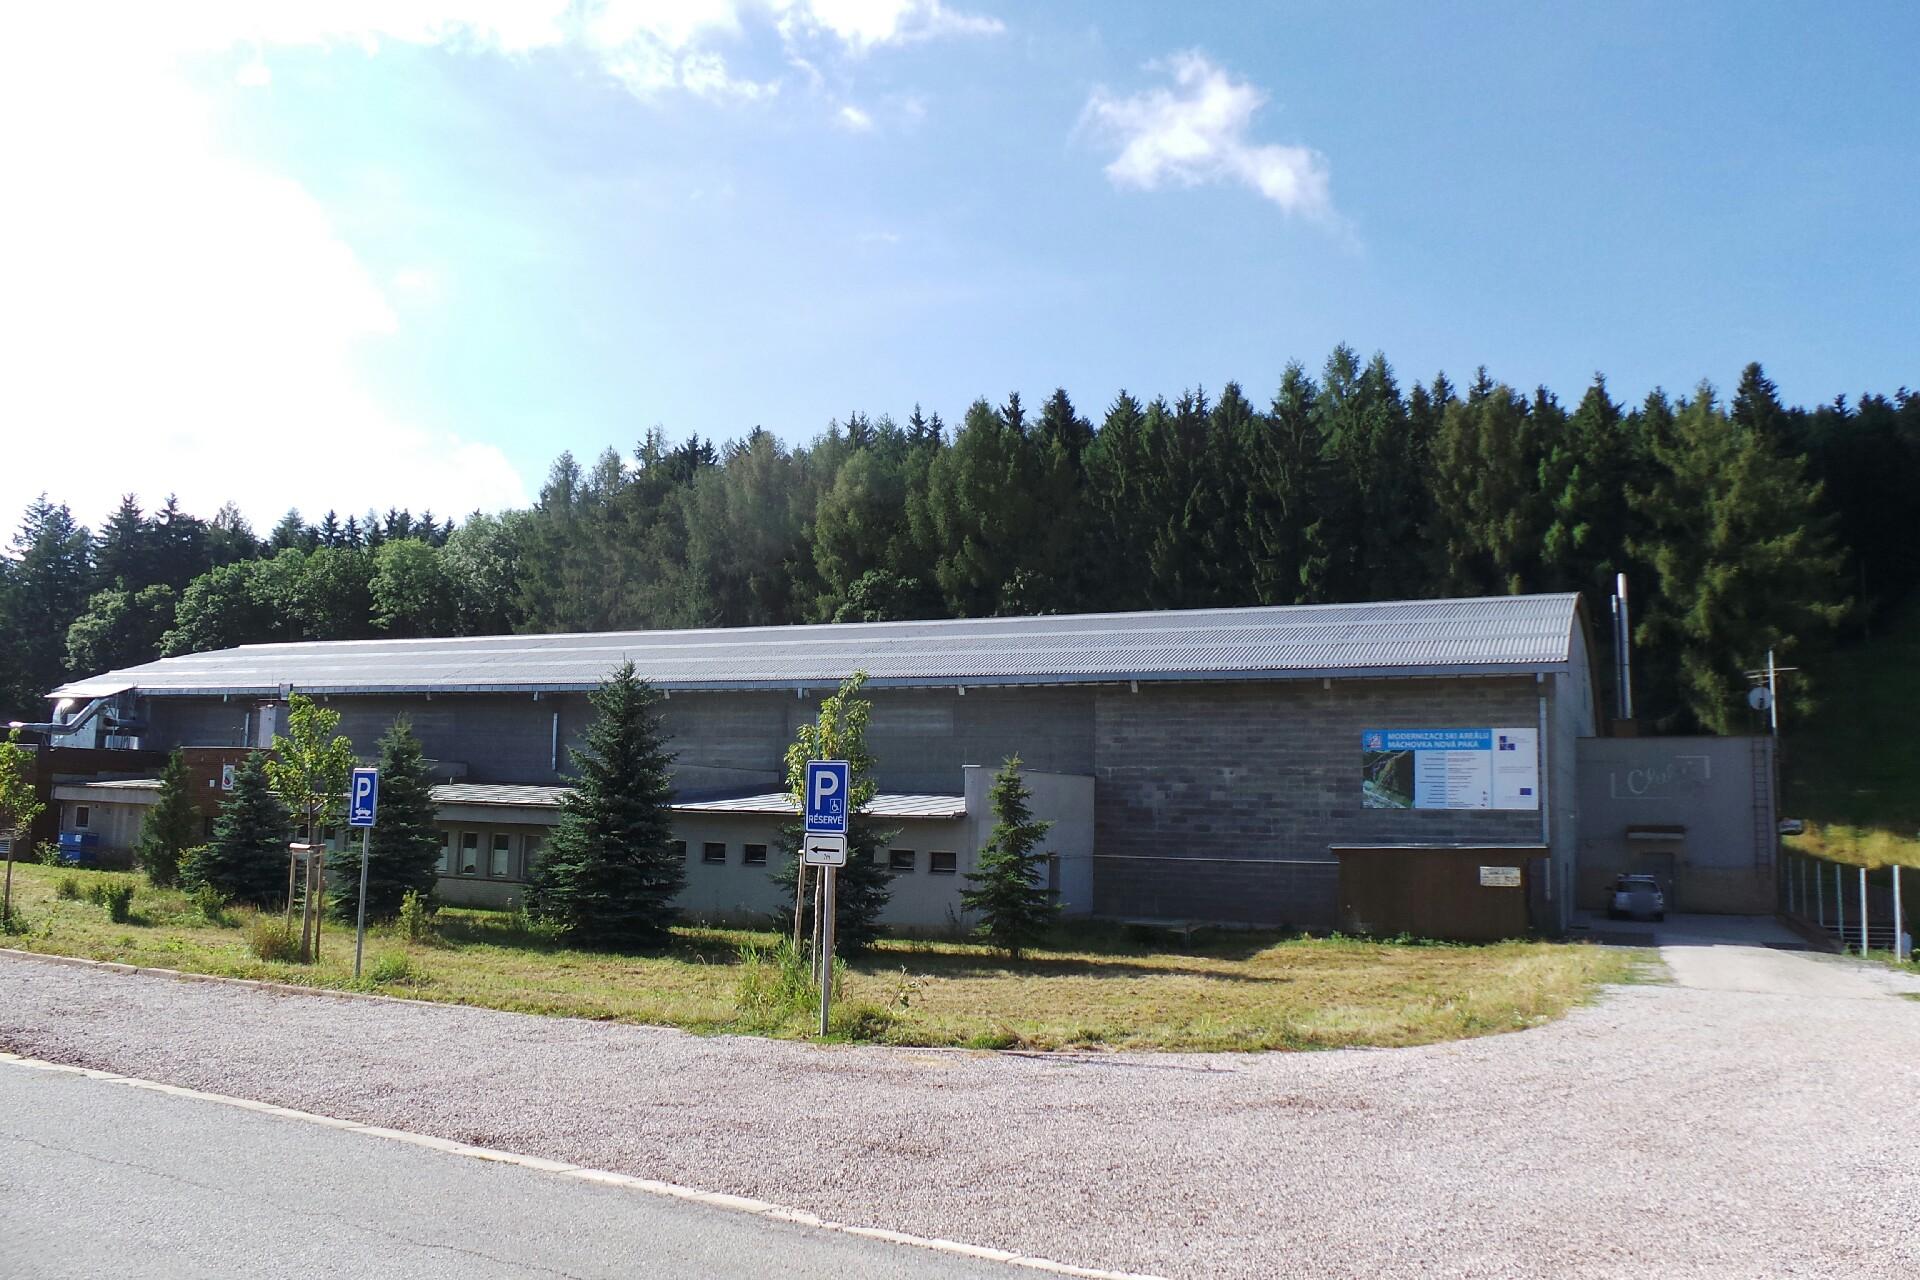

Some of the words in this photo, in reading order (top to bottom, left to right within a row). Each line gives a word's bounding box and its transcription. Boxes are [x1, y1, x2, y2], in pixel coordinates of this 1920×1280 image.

[1387, 732, 1443, 740] MODERNIZACE
[1445, 732, 1458, 740] SKI
[356, 777, 371, 808] P
[815, 771, 838, 810] P
[809, 813, 843, 824] RÉSERVÉ
